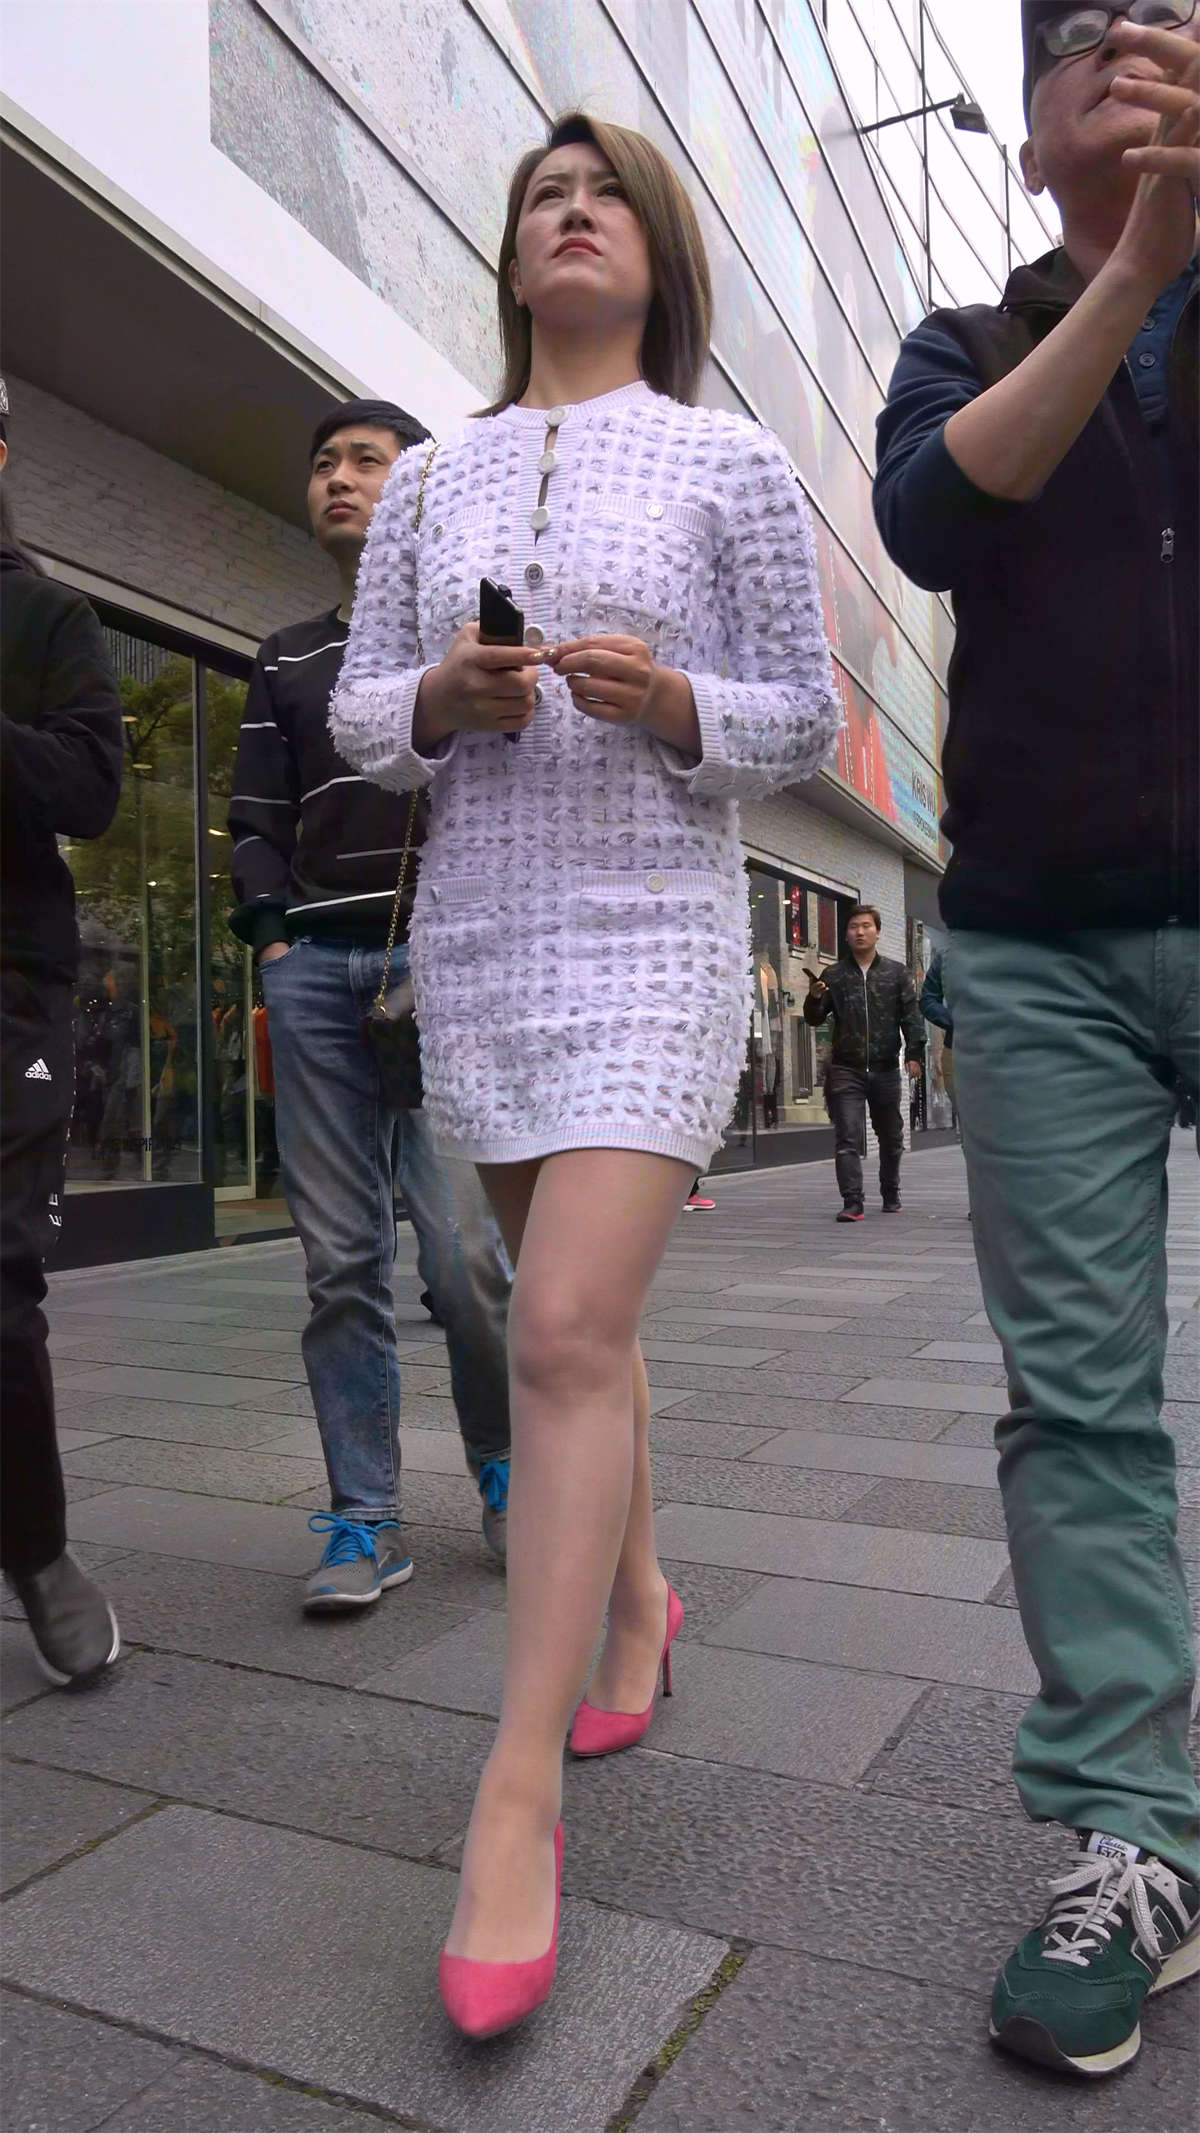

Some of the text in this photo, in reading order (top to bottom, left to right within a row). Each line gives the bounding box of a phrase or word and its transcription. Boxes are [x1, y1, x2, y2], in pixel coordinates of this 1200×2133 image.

[911, 768, 926, 809] KRIS
[25, 1071, 52, 1081] adidas
[1099, 1834, 1128, 1852] Classic
